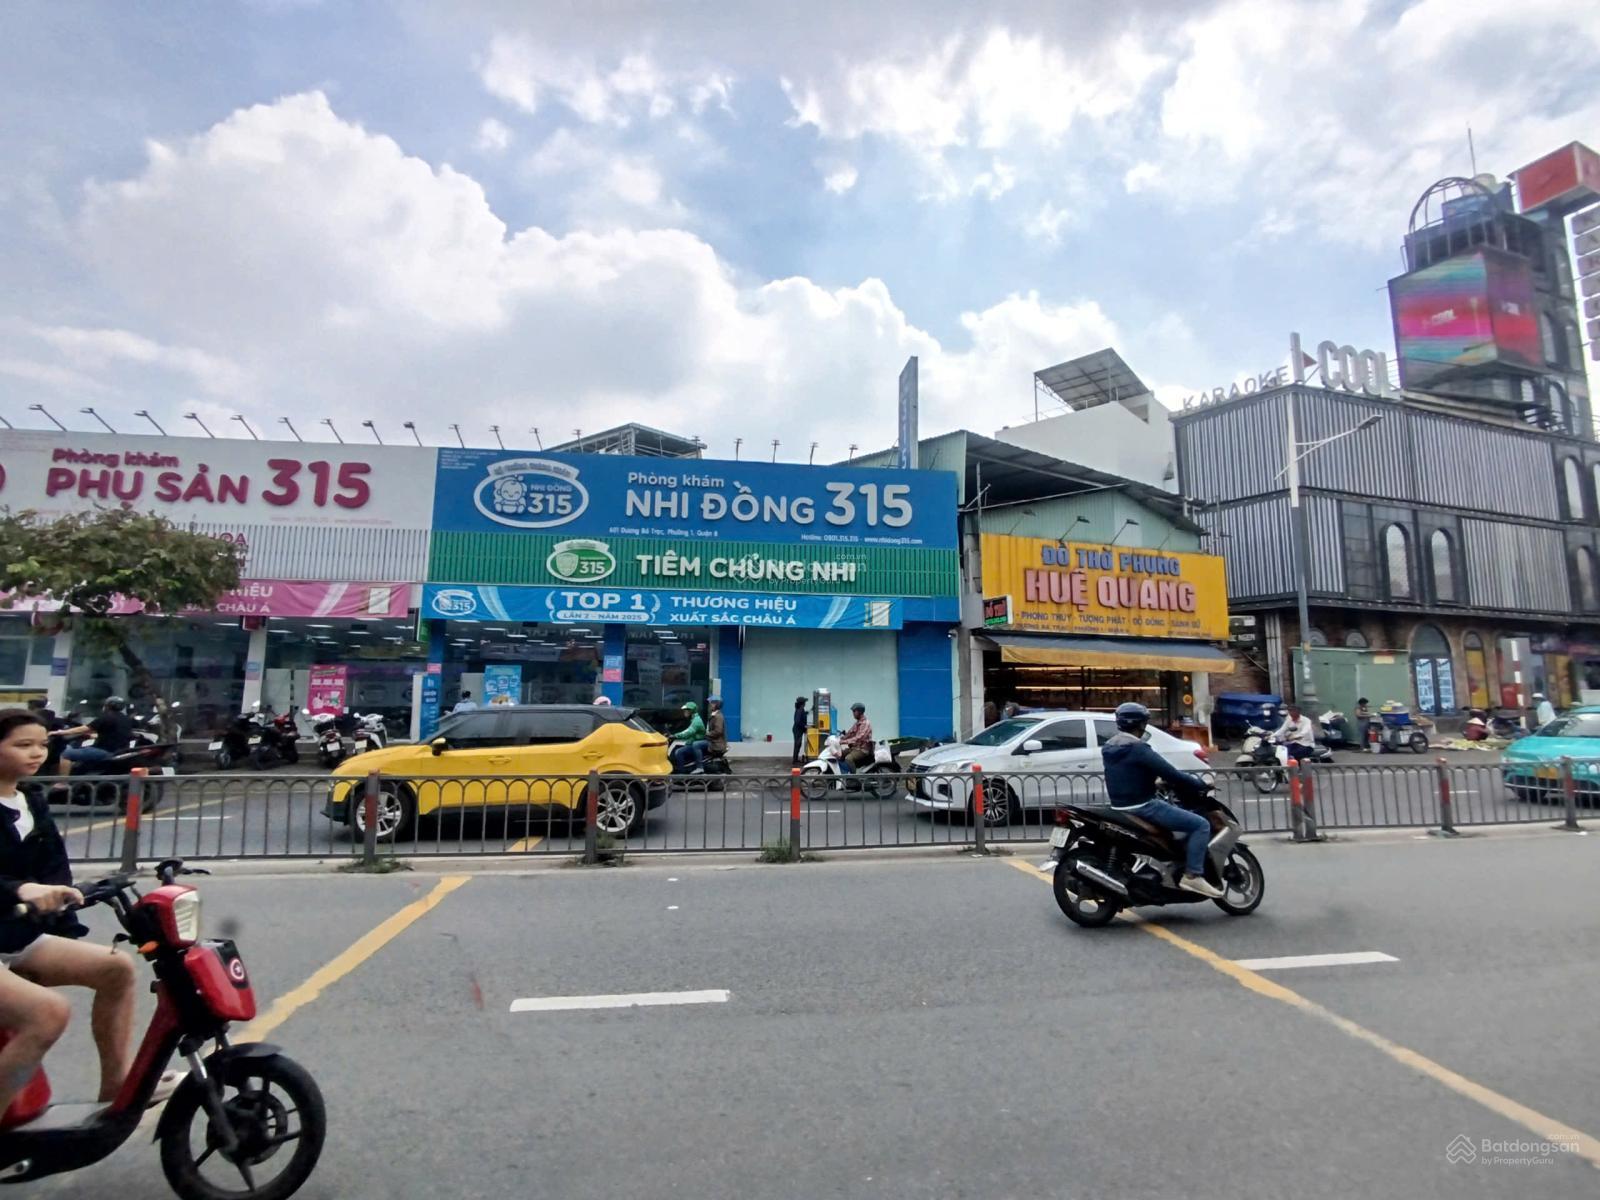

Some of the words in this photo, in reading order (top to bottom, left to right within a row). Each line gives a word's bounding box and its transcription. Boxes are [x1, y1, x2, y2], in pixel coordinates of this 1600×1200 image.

[1182, 365, 1290, 411] KARAOKE
[52, 447, 120, 468] Phòng
[124, 451, 179, 468] khám
[154, 463, 250, 504] SẢN
[262, 458, 372, 509] 315
[628, 472, 678, 488] Phòng
[682, 473, 725, 488] khám
[527, 493, 573, 515] 315
[625, 489, 690, 519] NHI
[700, 481, 816, 525] ĐỒNG
[824, 481, 914, 528] 315
[579, 561, 605, 574] 315
[636, 550, 701, 577] TIÊM
[709, 553, 805, 582] CHỦNG
[812, 561, 857, 583] NHI
[560, 591, 621, 610] TOP
[630, 593, 645, 610] 1
[1024, 567, 1089, 613] HUỆ
[1097, 574, 1196, 613] QUANG
[670, 595, 749, 609] THƯƠNG
[755, 596, 797, 613] HIỆU
[670, 611, 708, 623] XUẤT
[711, 611, 739, 623] SẮC
[743, 613, 782, 625] CHÂU
[785, 614, 796, 625] Á
